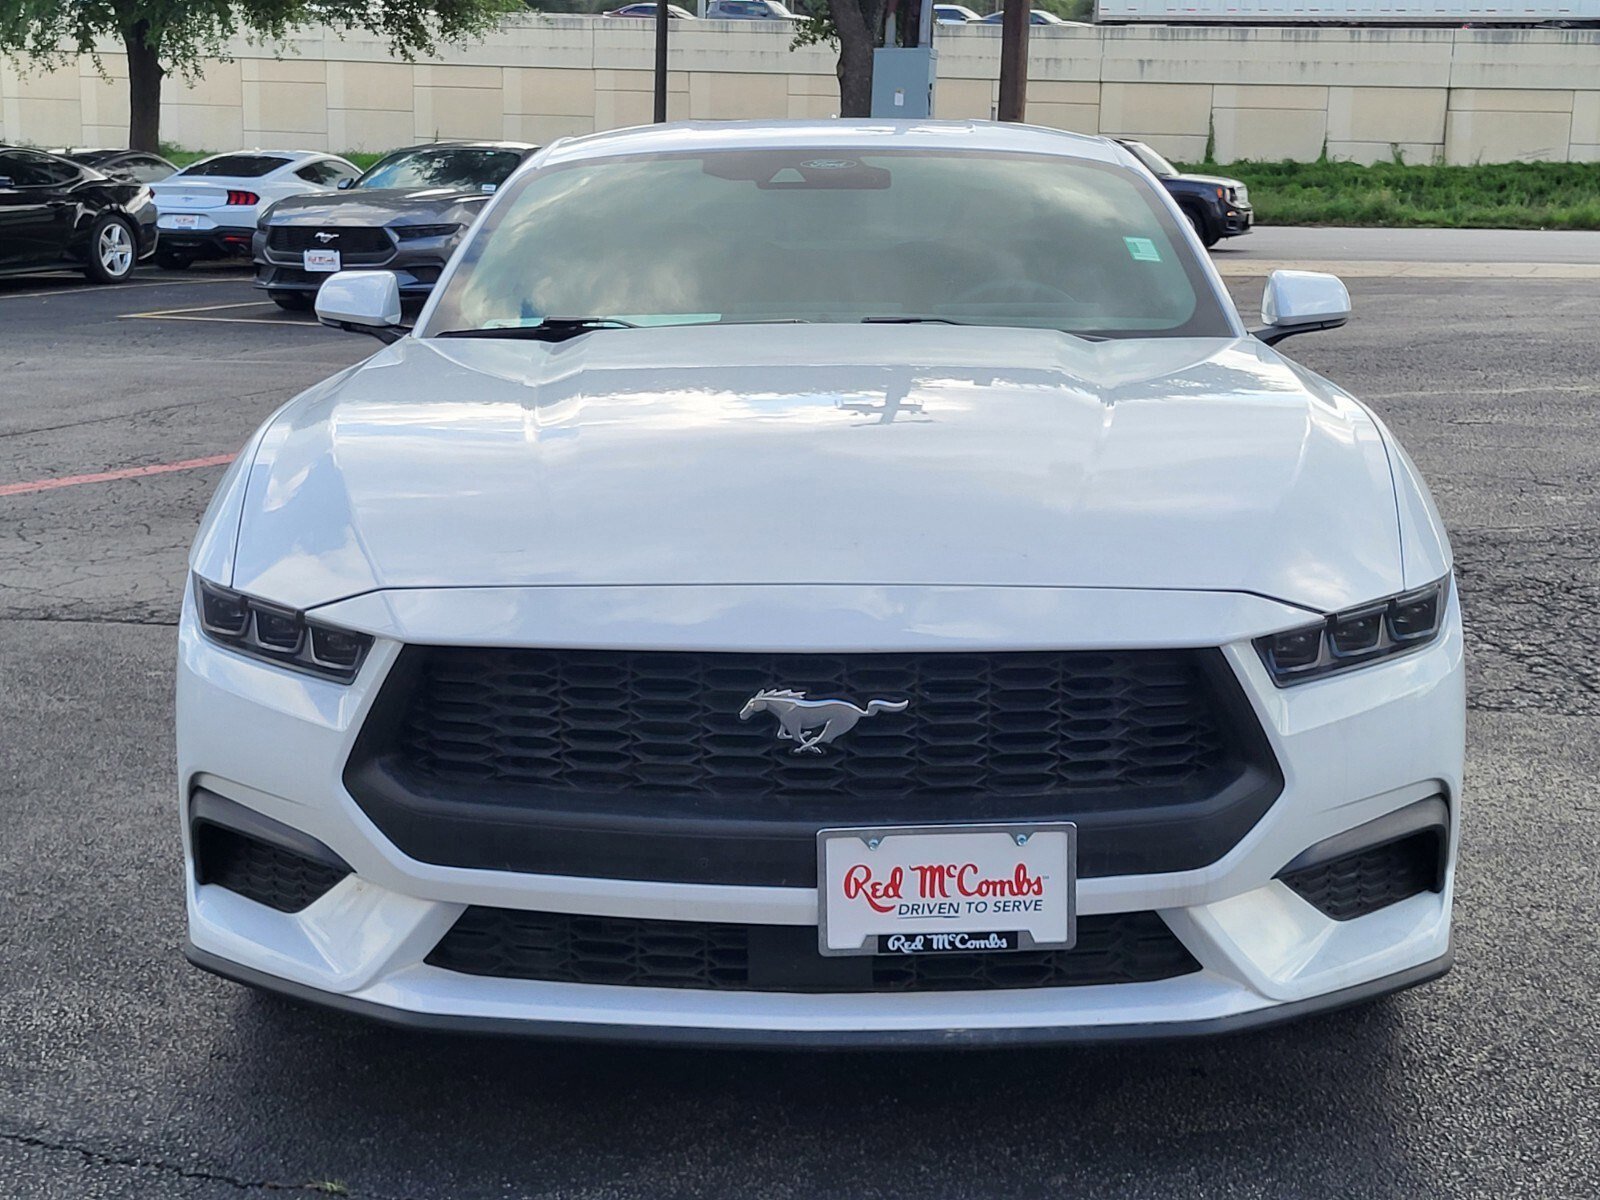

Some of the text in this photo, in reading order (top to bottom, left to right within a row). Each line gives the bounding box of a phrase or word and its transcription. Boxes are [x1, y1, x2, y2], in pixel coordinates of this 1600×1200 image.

[844, 863, 1043, 913] Red McCombs
[898, 899, 1043, 916] DRIVEN TO SERVE
[887, 934, 1008, 953] Red McCombs
